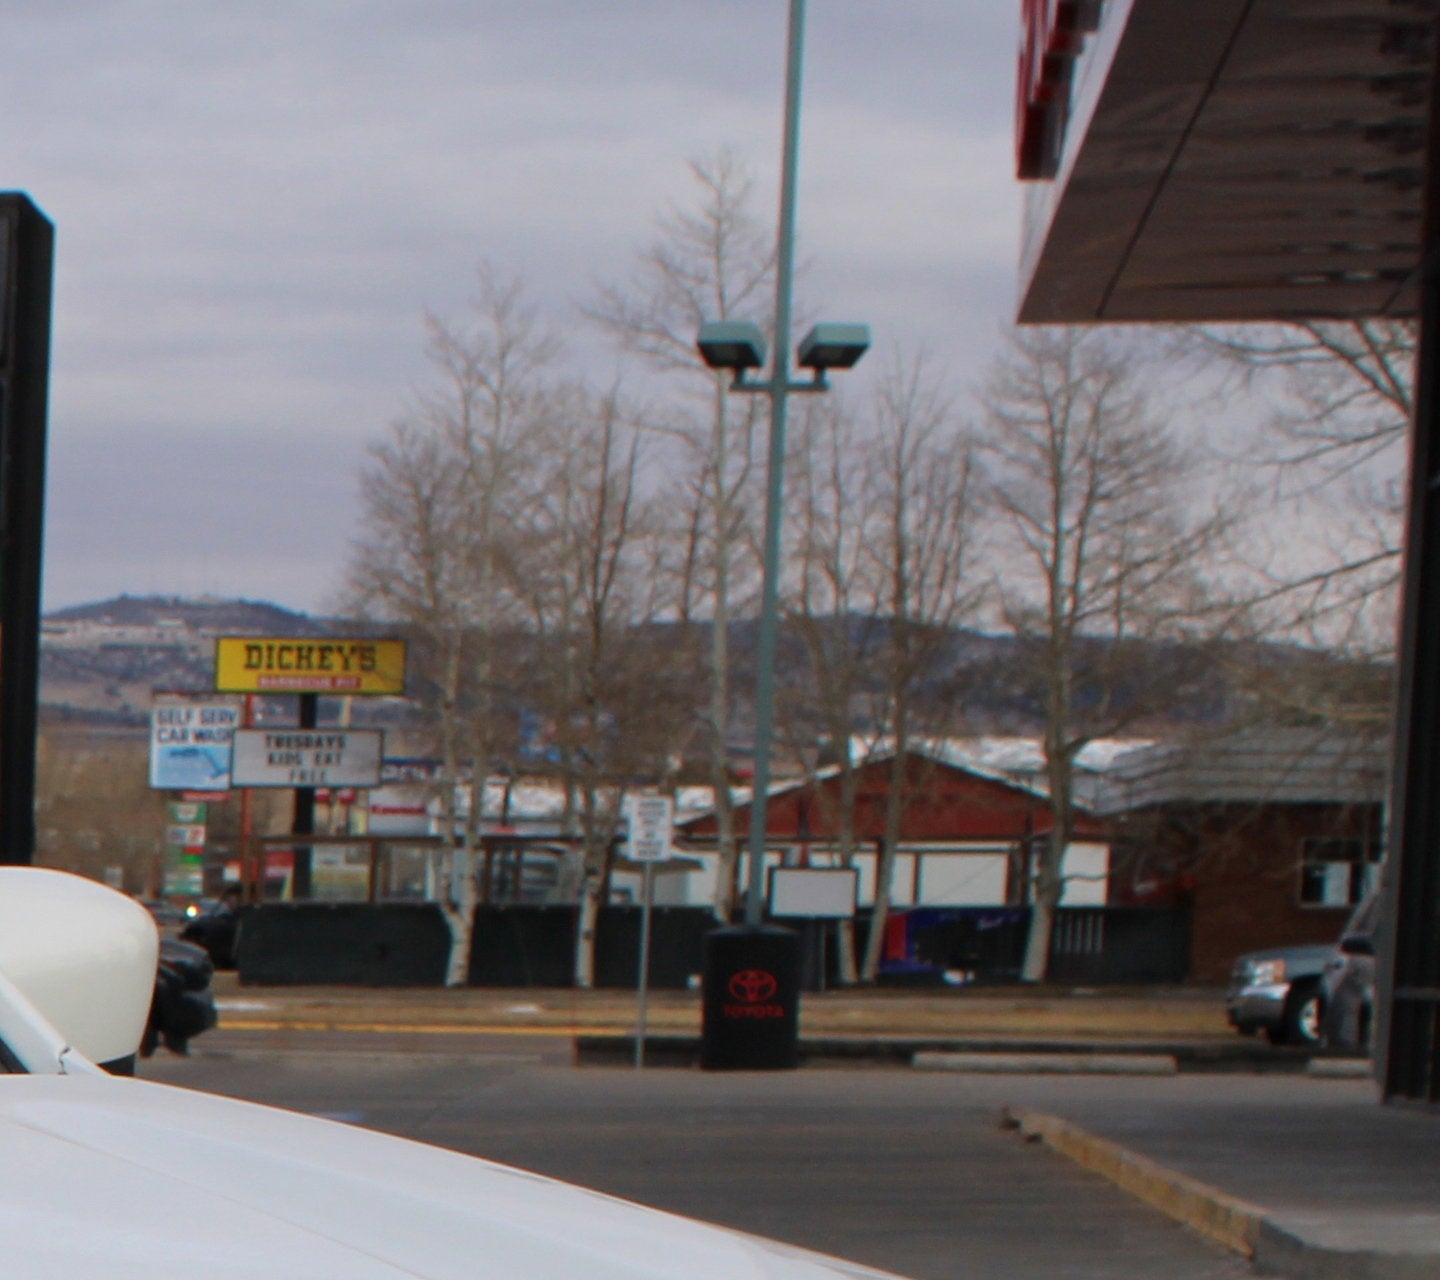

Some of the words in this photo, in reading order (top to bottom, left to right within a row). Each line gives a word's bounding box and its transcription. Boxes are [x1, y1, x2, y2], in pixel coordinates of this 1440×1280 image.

[244, 643, 377, 671] DICKEY'S
[158, 725, 189, 742] CAR
[265, 733, 346, 748] TUESDAYS
[266, 750, 302, 766] KIDS
[312, 750, 342, 766] EAT
